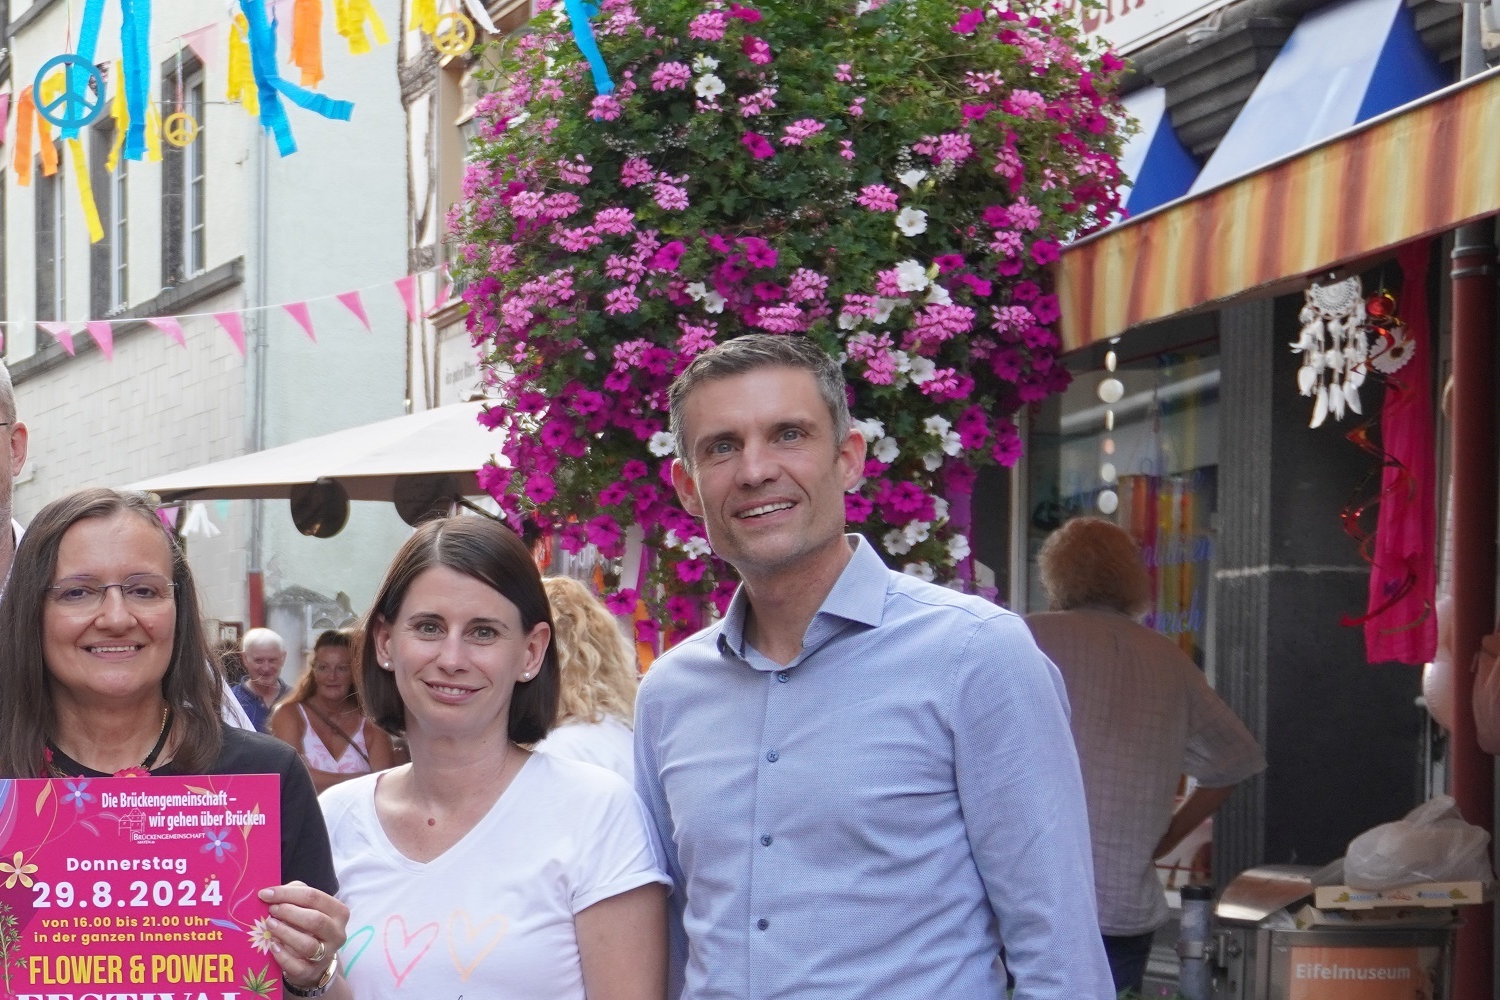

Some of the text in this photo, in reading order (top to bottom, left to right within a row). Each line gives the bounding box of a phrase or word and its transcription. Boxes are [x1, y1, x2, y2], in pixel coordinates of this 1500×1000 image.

[101, 792, 119, 808] Die
[120, 790, 228, 811] Brückengemeinschaft
[149, 809, 266, 831] wir gehen über Brücken
[66, 856, 188, 874] Donnerstag
[31, 879, 223, 908] 29.8.2024
[42, 915, 211, 928] von 16.00 bis 21.00 Uhr
[34, 929, 223, 945] in der ganzen Innenstadt
[29, 953, 235, 985] FLOWER & POWER
[1296, 963, 1410, 980] Eifelmuseum
